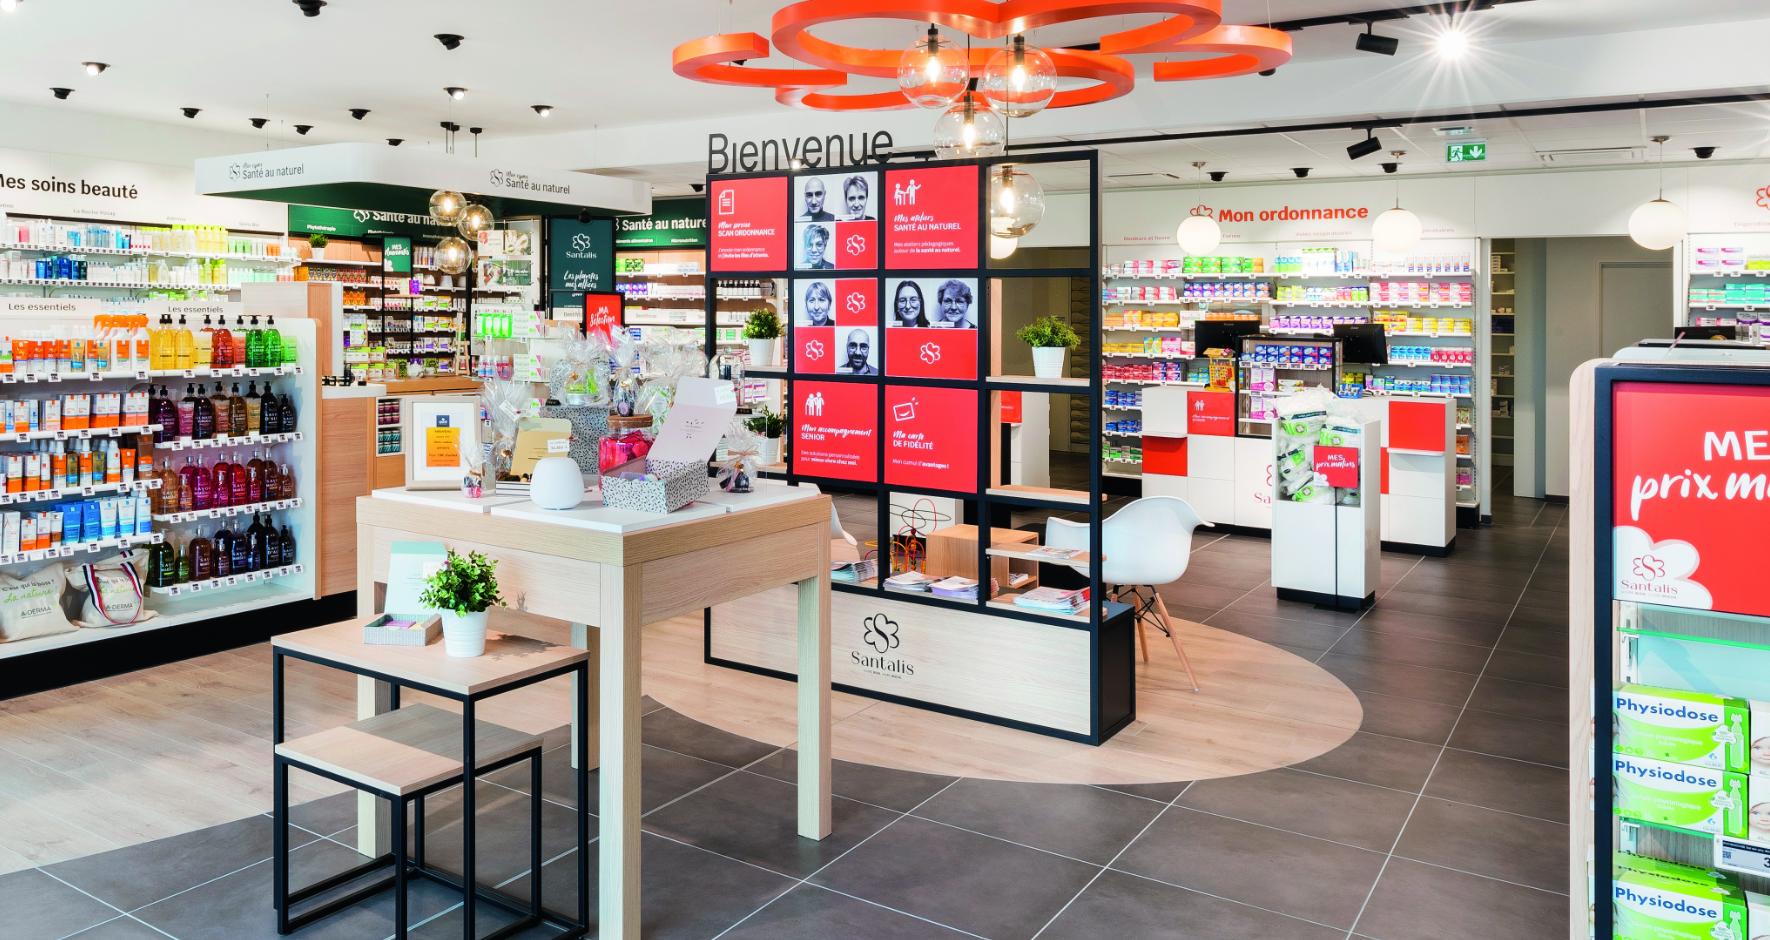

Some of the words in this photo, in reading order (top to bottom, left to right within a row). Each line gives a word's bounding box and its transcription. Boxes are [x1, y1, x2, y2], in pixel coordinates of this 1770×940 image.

[709, 130, 894, 174] Bienvenue
[242, 168, 263, 179] Santé
[265, 169, 274, 177] au
[276, 163, 304, 176] naturel
[32, 176, 76, 194] soins
[81, 179, 138, 199] beauté
[506, 178, 529, 190] Santé
[531, 182, 540, 191] au
[542, 184, 570, 194] naturel
[894, 214, 908, 223] Mes
[910, 211, 934, 222] ateliers
[1218, 209, 1254, 222] Mon
[1259, 206, 1368, 222] ordonnance
[622, 218, 653, 231] Santé
[655, 220, 668, 229] au
[894, 223, 916, 232] SANTÉ
[28, 303, 76, 311] essentiels
[598, 306, 609, 314] MA
[818, 427, 872, 438] accompagnement
[893, 430, 906, 439] Ma
[904, 440, 933, 450] FIDÉLITÉ
[1630, 469, 1718, 521] prix
[21, 588, 53, 600] nature
[1621, 580, 1678, 594] Santalis
[851, 651, 914, 675] Santalis
[1616, 698, 1718, 722] Physiodose
[1616, 760, 1717, 787] Physiodose
[1616, 887, 1718, 918] Physiodose
